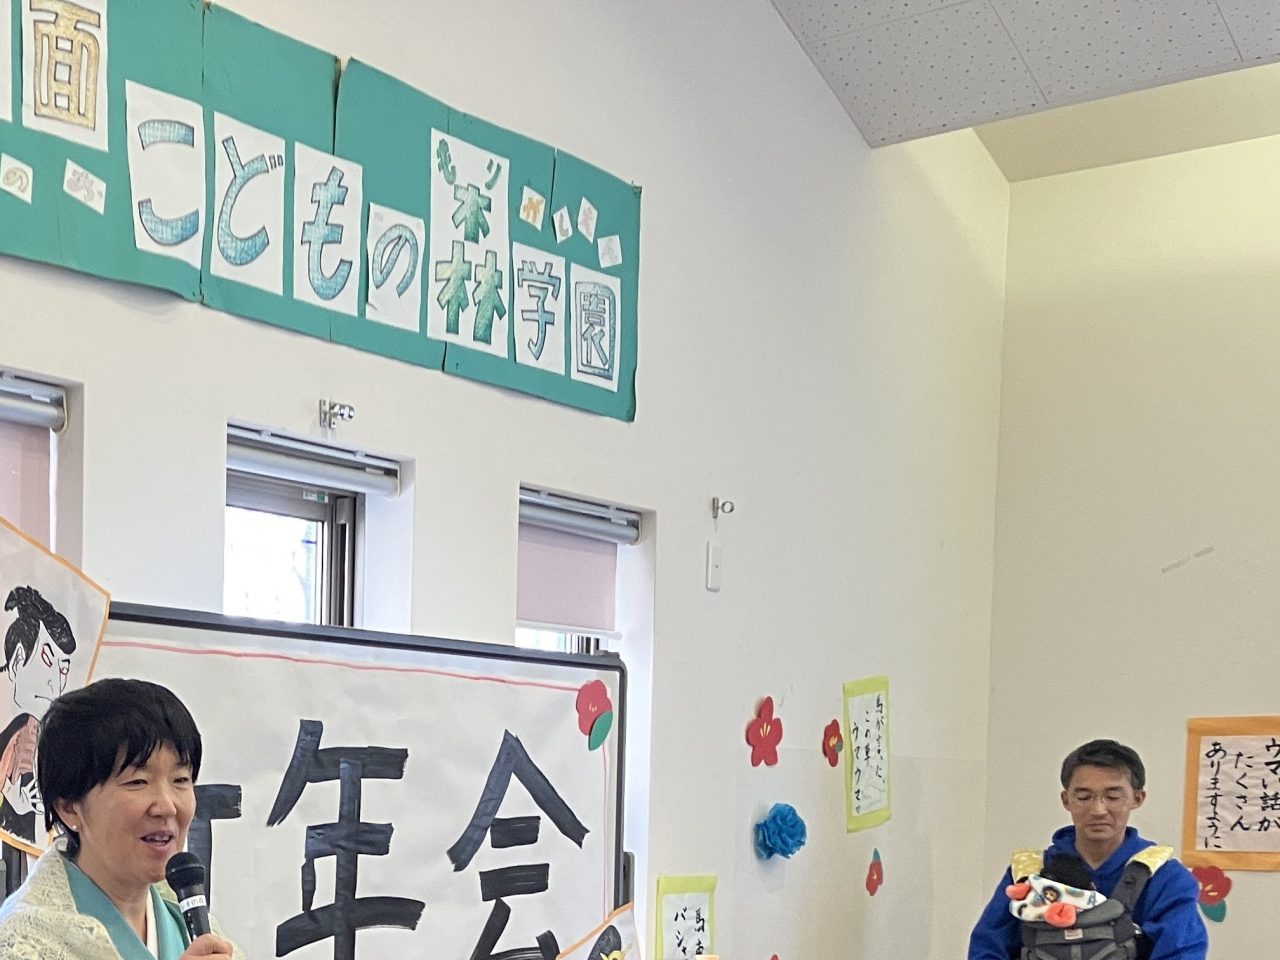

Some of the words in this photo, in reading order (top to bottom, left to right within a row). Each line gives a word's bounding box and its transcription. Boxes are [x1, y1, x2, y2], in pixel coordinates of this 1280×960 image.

[1204, 742, 1228, 849] ありますように
[1230, 751, 1254, 832] たくさん
